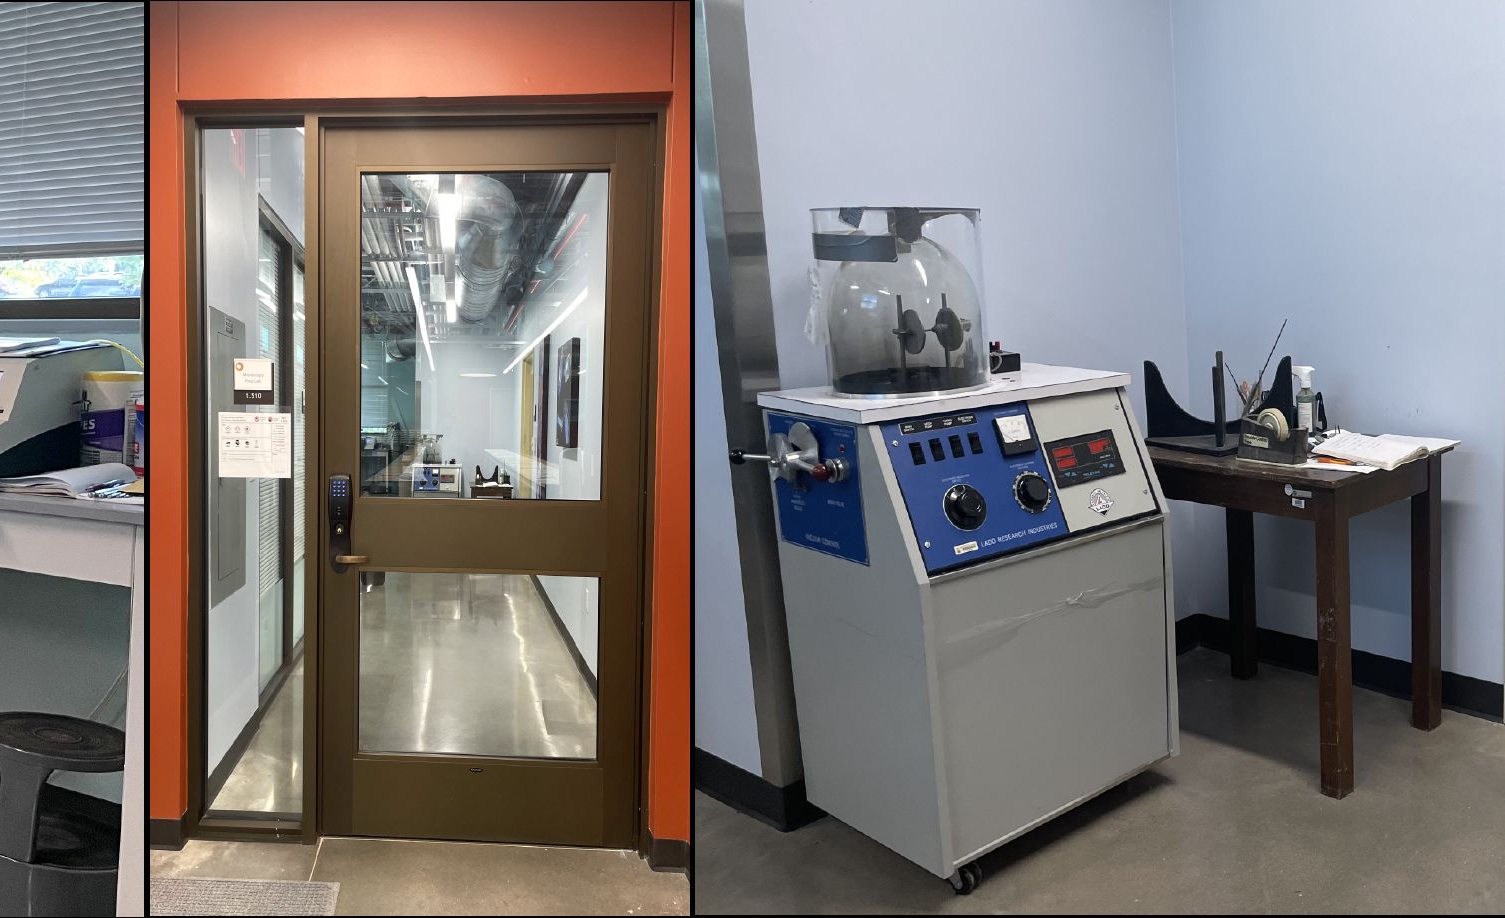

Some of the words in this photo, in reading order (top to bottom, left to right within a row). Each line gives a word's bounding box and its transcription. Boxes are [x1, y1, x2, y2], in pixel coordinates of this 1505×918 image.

[981, 537, 996, 548] LADD
[997, 530, 1027, 543] RESEARCH
[1027, 521, 1058, 535] INDUSTRIES
